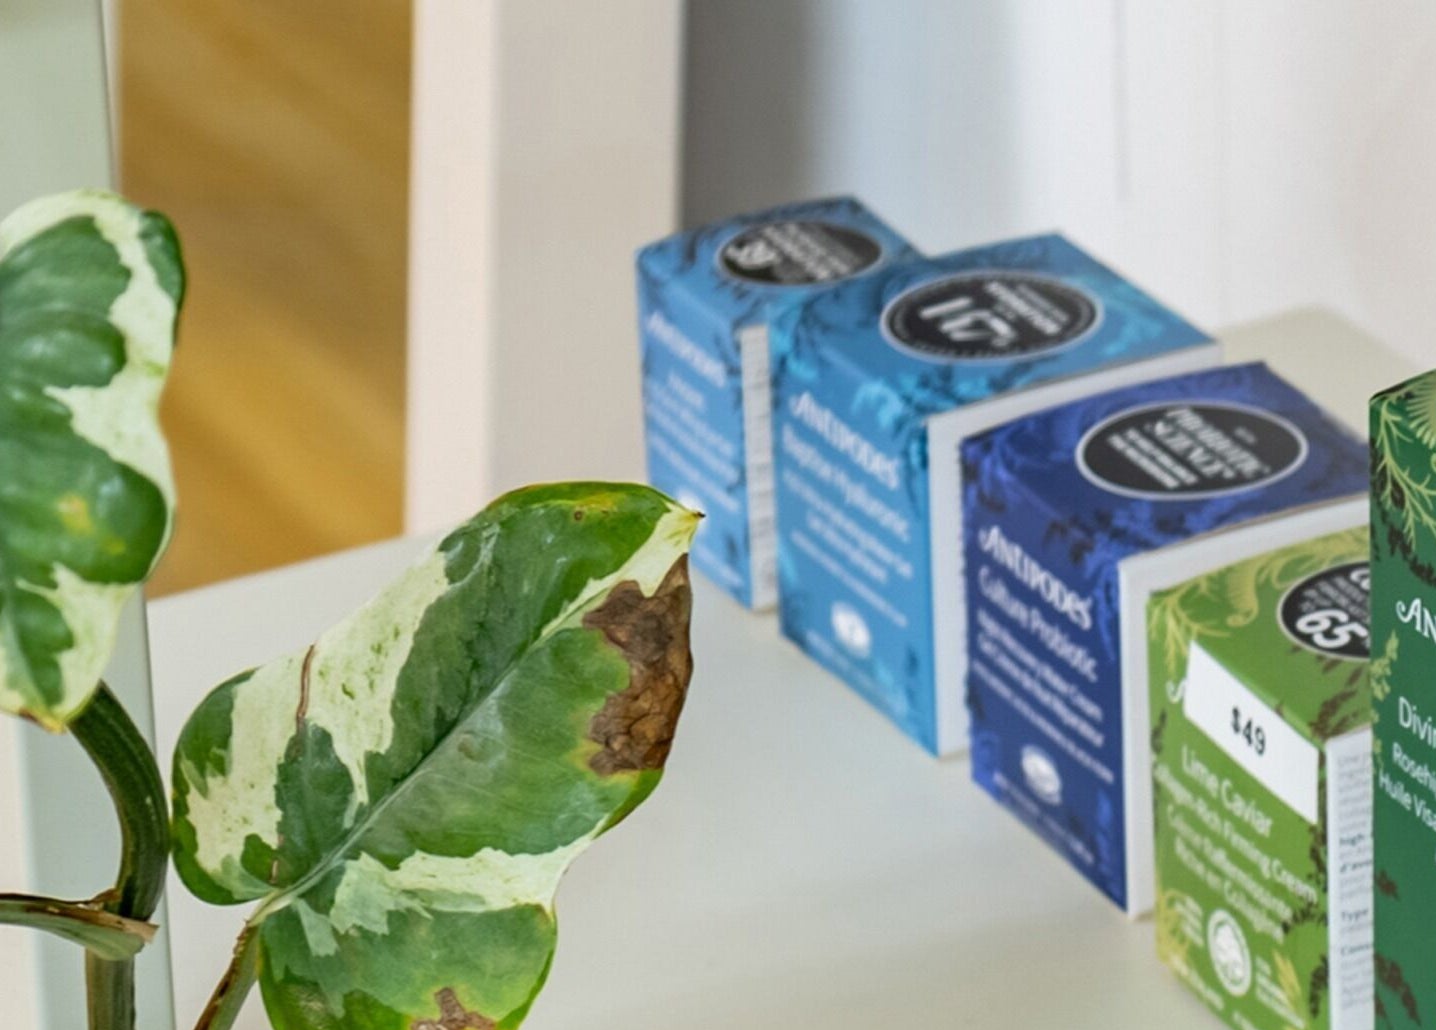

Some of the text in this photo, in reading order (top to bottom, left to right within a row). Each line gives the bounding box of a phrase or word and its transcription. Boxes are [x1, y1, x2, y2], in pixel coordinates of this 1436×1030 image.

[1231, 706, 1266, 757] $49
[1181, 746, 1273, 837] Lime Caviar
[1378, 769, 1412, 811] Huile
